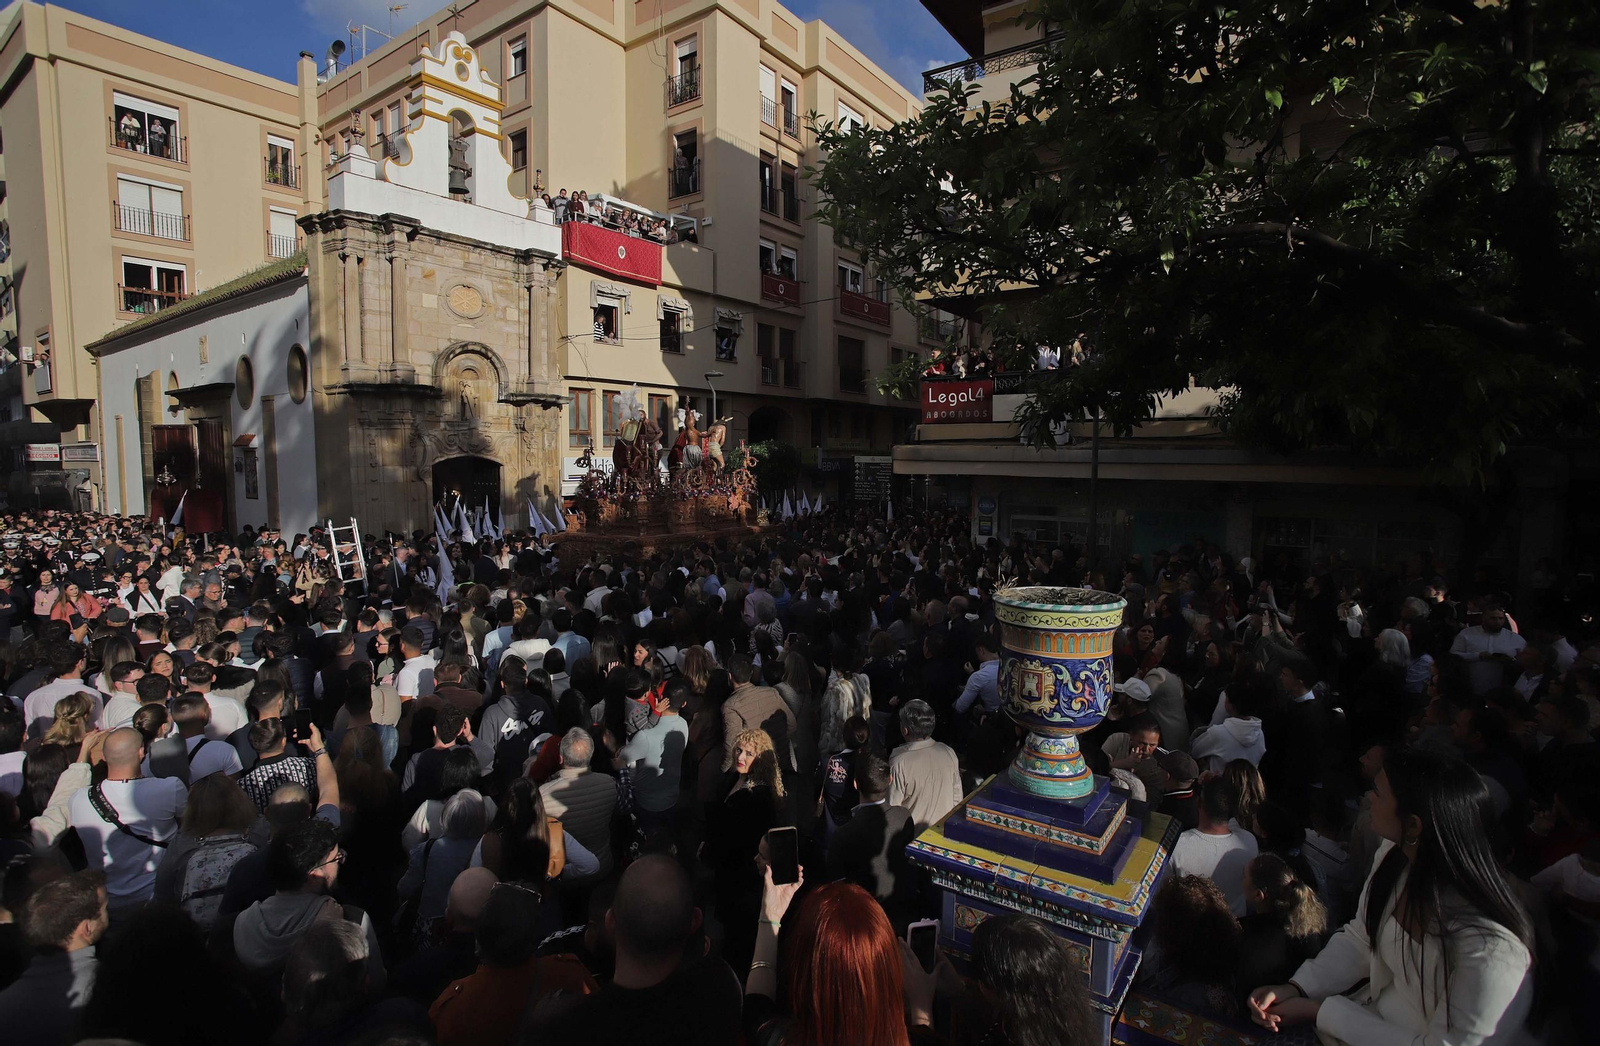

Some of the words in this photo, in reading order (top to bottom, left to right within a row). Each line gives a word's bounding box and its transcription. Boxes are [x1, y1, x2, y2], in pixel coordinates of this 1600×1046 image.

[928, 387, 985, 407] Legal4
[926, 409, 988, 419] ABOGADOS
[822, 461, 841, 472] BBVA
